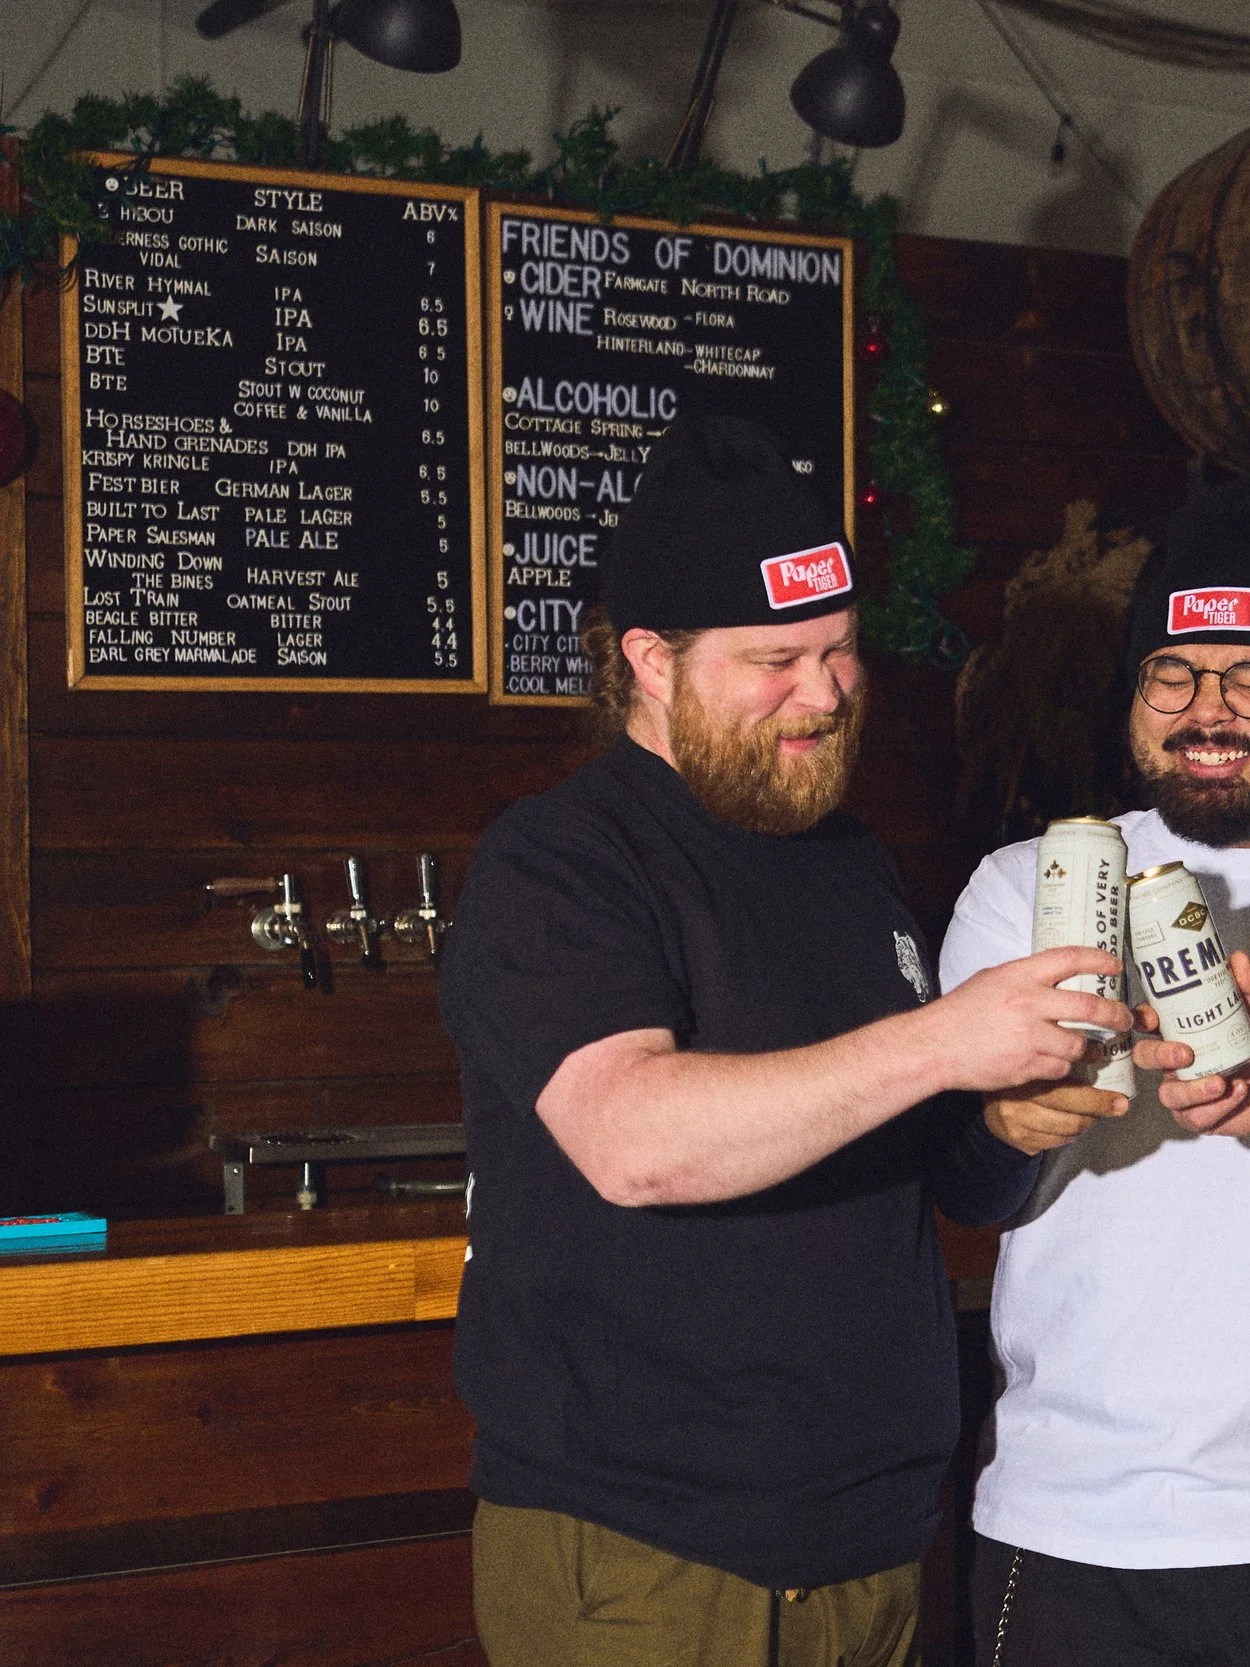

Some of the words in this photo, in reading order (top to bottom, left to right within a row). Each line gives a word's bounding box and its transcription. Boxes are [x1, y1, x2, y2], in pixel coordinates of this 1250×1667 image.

[255, 189, 322, 211] STYLE
[403, 202, 457, 222] ABV%
[237, 215, 276, 232] DARK
[292, 220, 341, 238] SAISON
[179, 236, 227, 254] GOTHIC
[427, 230, 435, 243] 6
[140, 252, 180, 268] VIDAL
[256, 245, 317, 266] SAISON
[502, 220, 631, 265] FRIENDS
[655, 238, 692, 270] OF
[713, 241, 841, 285] DOMINION
[428, 262, 435, 275] 7
[85, 268, 134, 290] RIVER
[148, 277, 211, 296] HYMNAL
[521, 261, 601, 299] CIDER
[605, 271, 666, 294] FARMGATE
[682, 278, 739, 300] NORTH
[747, 284, 789, 304] ROAD
[275, 287, 302, 301] IPA
[84, 294, 153, 316] SUNSPLIT
[421, 298, 443, 312] 6.5
[276, 308, 312, 328] IPA
[520, 298, 593, 335] WINE
[604, 308, 676, 330] ROSEWOOD
[85, 321, 130, 340] DDH
[141, 326, 233, 347] MOTUEKA
[419, 318, 447, 336] 6.5
[277, 333, 307, 352] IPA
[86, 345, 124, 365] BTE
[265, 357, 325, 377] STOUT
[424, 368, 438, 384] 10
[90, 372, 126, 391] BTE
[239, 380, 282, 398] STOUT
[289, 385, 301, 399] W
[308, 386, 364, 404] COCONUT
[517, 377, 677, 420] ALCOHOLIC
[234, 402, 286, 419] COFFEE
[297, 406, 307, 420] &
[316, 405, 372, 423] VANILLA
[424, 398, 439, 412] 10
[86, 409, 214, 434] HORSESHOES
[219, 417, 232, 434] &
[505, 412, 581, 434] COTTAGE
[591, 419, 642, 438] SPRING
[107, 427, 166, 449] HAND
[175, 436, 268, 454] GRENADES
[422, 430, 444, 445] 6.5
[326, 443, 345, 458] IPA
[82, 450, 134, 466] KRISPY
[144, 454, 208, 471] KRINGLE
[270, 459, 298, 474] IPA
[215, 478, 289, 498] GERMAN
[299, 481, 352, 501] LAGER
[421, 490, 447, 505] 5.5
[87, 501, 137, 518] BUILT
[141, 503, 167, 518] TO
[178, 501, 220, 521] LAST
[245, 507, 286, 523] PALE
[301, 509, 352, 525] LAGER
[505, 499, 580, 521] BELLWOODS
[438, 515, 446, 529] 5
[87, 523, 136, 543] PAPER
[147, 526, 215, 545] SALESMAN
[246, 528, 289, 548] PALE
[299, 531, 338, 549] ALE
[439, 539, 448, 553] 5
[515, 532, 597, 566] JUICE
[84, 549, 164, 569] WINDING
[178, 552, 222, 570] DOWN
[132, 573, 165, 589] THE
[171, 574, 213, 590] BINES
[247, 568, 325, 585] HARVEST
[334, 570, 358, 587] ALE
[437, 571, 448, 589] 5
[507, 567, 571, 587] APPLE
[780, 557, 834, 588] Paper
[812, 574, 838, 593] TIGER
[83, 587, 121, 606] LOST
[130, 589, 179, 606] TRAIN
[227, 594, 294, 610] OATMEAL
[309, 593, 351, 611] STOUT
[427, 597, 454, 613] 5.5
[514, 599, 583, 632] CITY
[1183, 595, 1239, 619] Paper
[86, 610, 138, 625] BEAGLE
[150, 611, 197, 626] BITTER
[271, 614, 321, 628] BITTER
[433, 617, 453, 631] 4.4
[1208, 611, 1236, 624] TIGER
[90, 629, 153, 645] FALLING
[171, 630, 235, 646] NUMBER
[277, 633, 323, 647] LAGER
[432, 632, 457, 649] 4.4
[512, 634, 550, 652] CITY
[90, 647, 127, 663] EARL
[135, 647, 170, 662] GREY
[175, 647, 256, 664] MARMALADE
[278, 647, 326, 665] SAISON
[435, 651, 457, 667] 5.5
[510, 654, 561, 674] BERRY
[509, 676, 549, 694] COOL
[1096, 858, 1111, 903] VERY
[1110, 885, 1119, 928] BEER
[1096, 910, 1106, 934] OF
[1177, 1004, 1223, 1028] LIGHT
